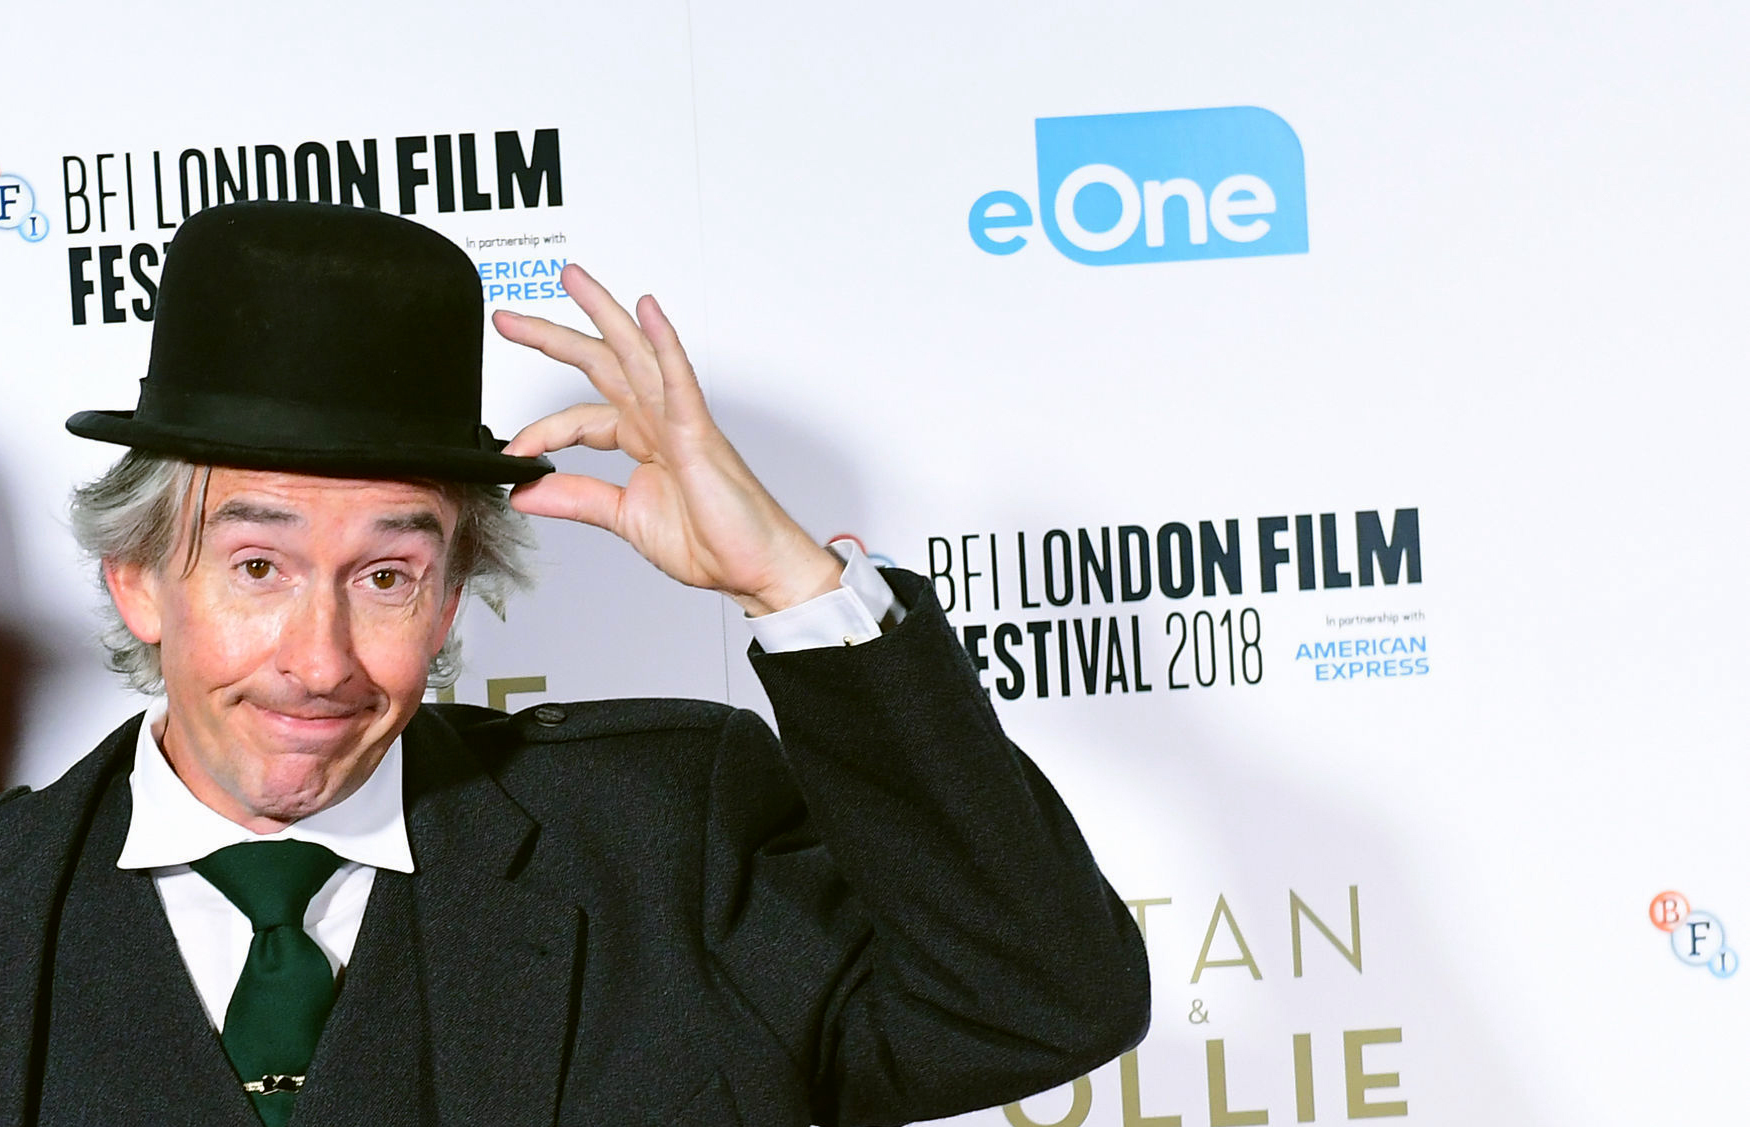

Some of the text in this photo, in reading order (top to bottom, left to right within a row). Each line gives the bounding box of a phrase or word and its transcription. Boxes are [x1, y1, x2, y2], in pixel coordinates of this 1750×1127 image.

[61, 127, 564, 235] BFI LONDON FILM
[967, 163, 1277, 256] eOne
[478, 233, 540, 251] partnership
[543, 232, 567, 244] with
[477, 258, 568, 281] ERICAN
[928, 507, 1423, 613] BFI LONDON FILM
[1339, 611, 1399, 629] partnership
[1402, 609, 1426, 622] with
[950, 606, 1264, 701] ESTIVAL 2018
[1295, 636, 1428, 661] AMERICAN
[1314, 657, 1430, 682] EXPRESS
[1188, 998, 1210, 1025] &
